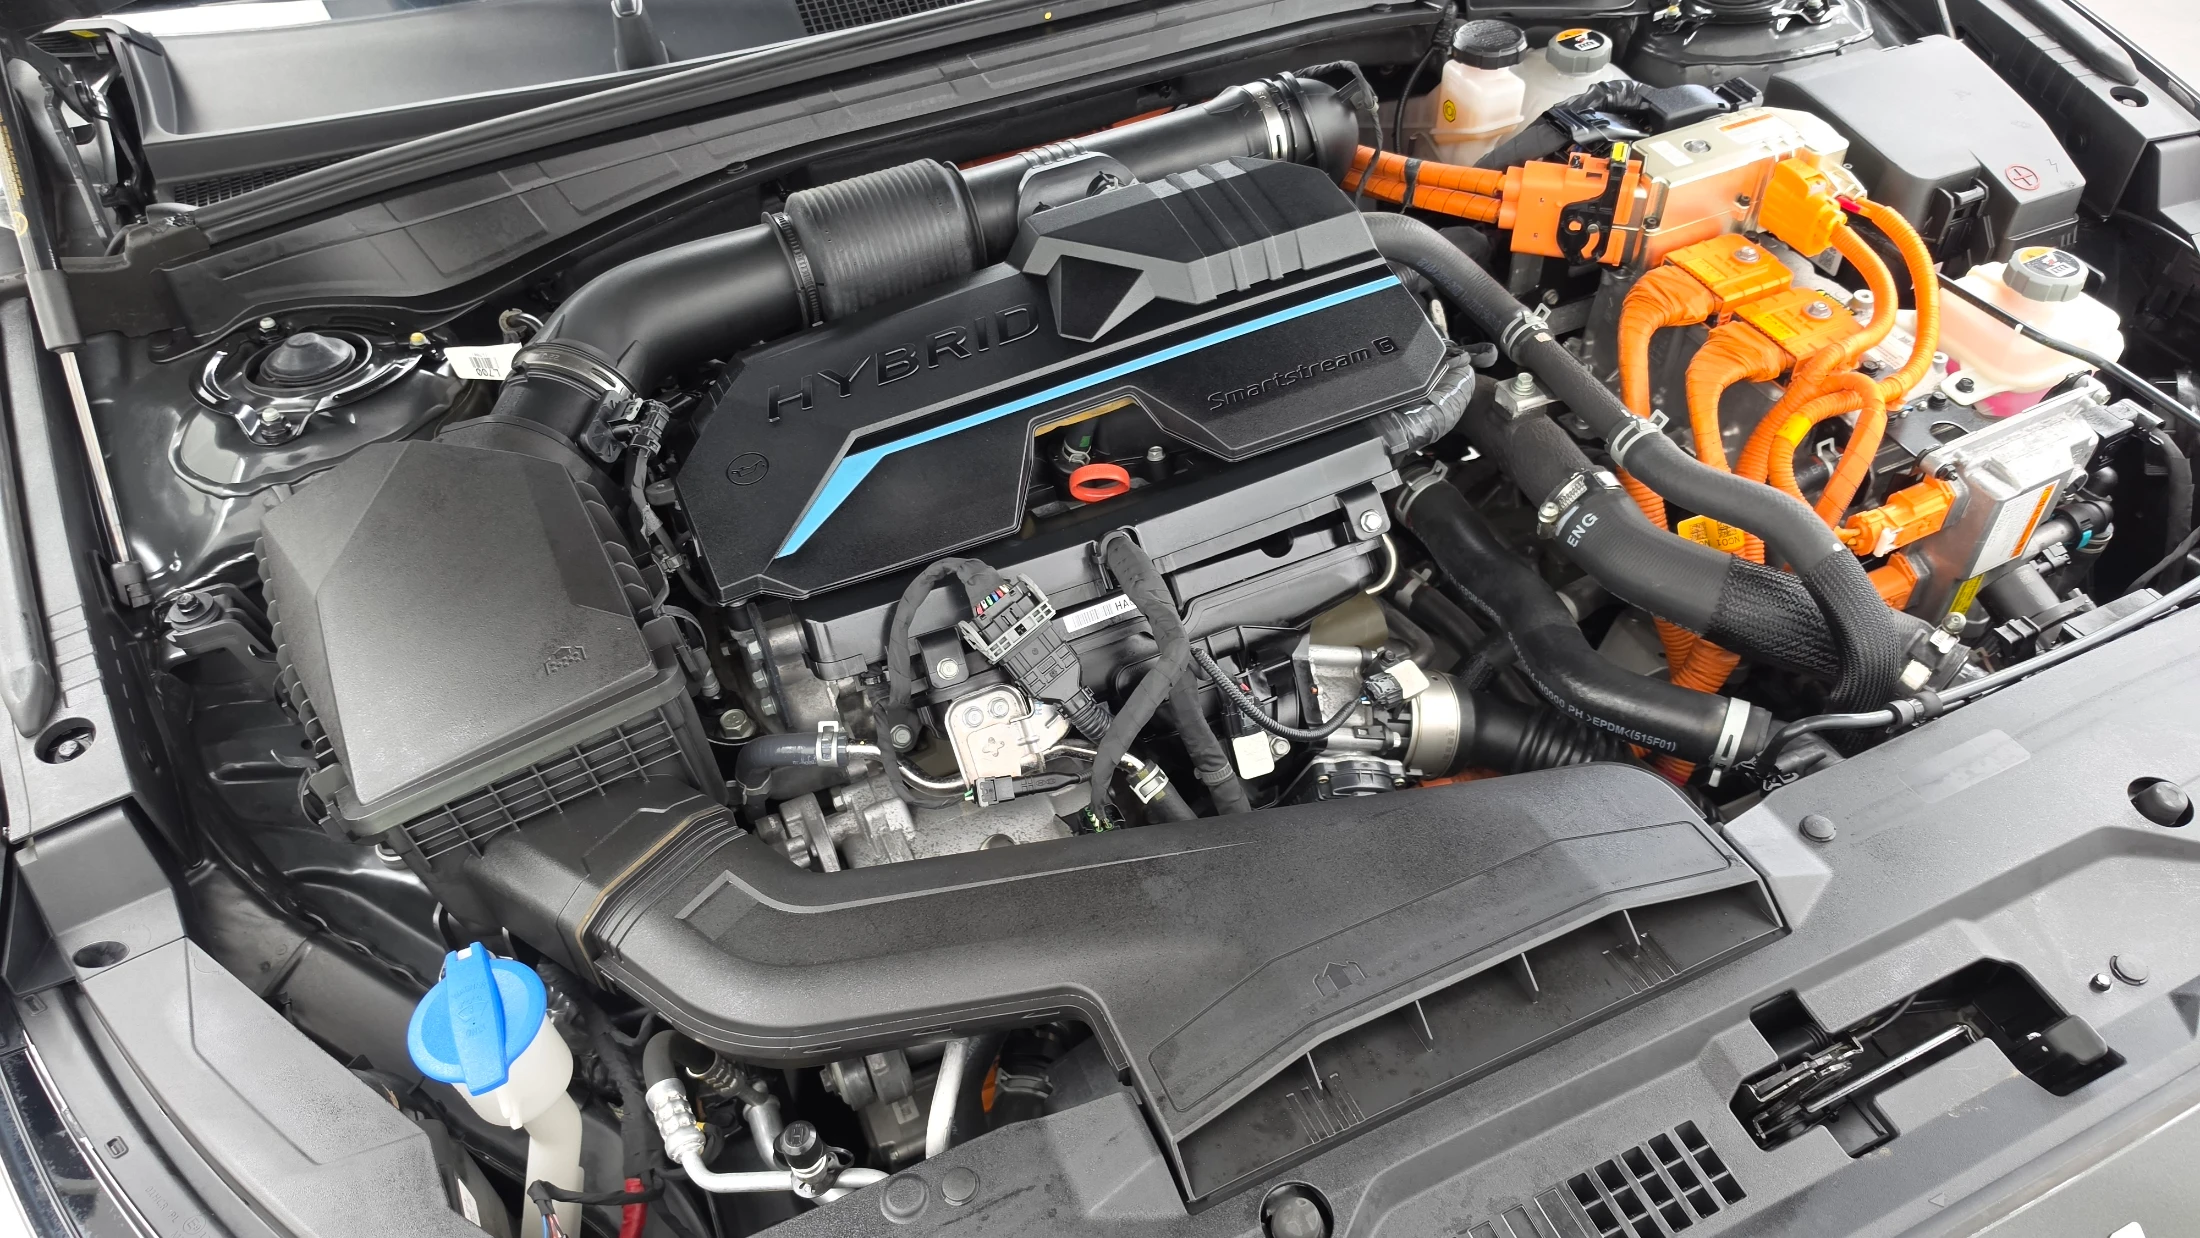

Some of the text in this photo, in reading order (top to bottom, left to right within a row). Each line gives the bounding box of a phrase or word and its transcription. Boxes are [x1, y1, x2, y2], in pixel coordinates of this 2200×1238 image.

[767, 302, 1039, 423] HYBRID
[1207, 347, 1371, 412] Smartstream
[1566, 512, 1599, 548] ENG
[1716, 535, 1741, 547] NC01
[1567, 703, 1585, 719] PH
[1586, 713, 1677, 752] >EPDM<(515F01)
